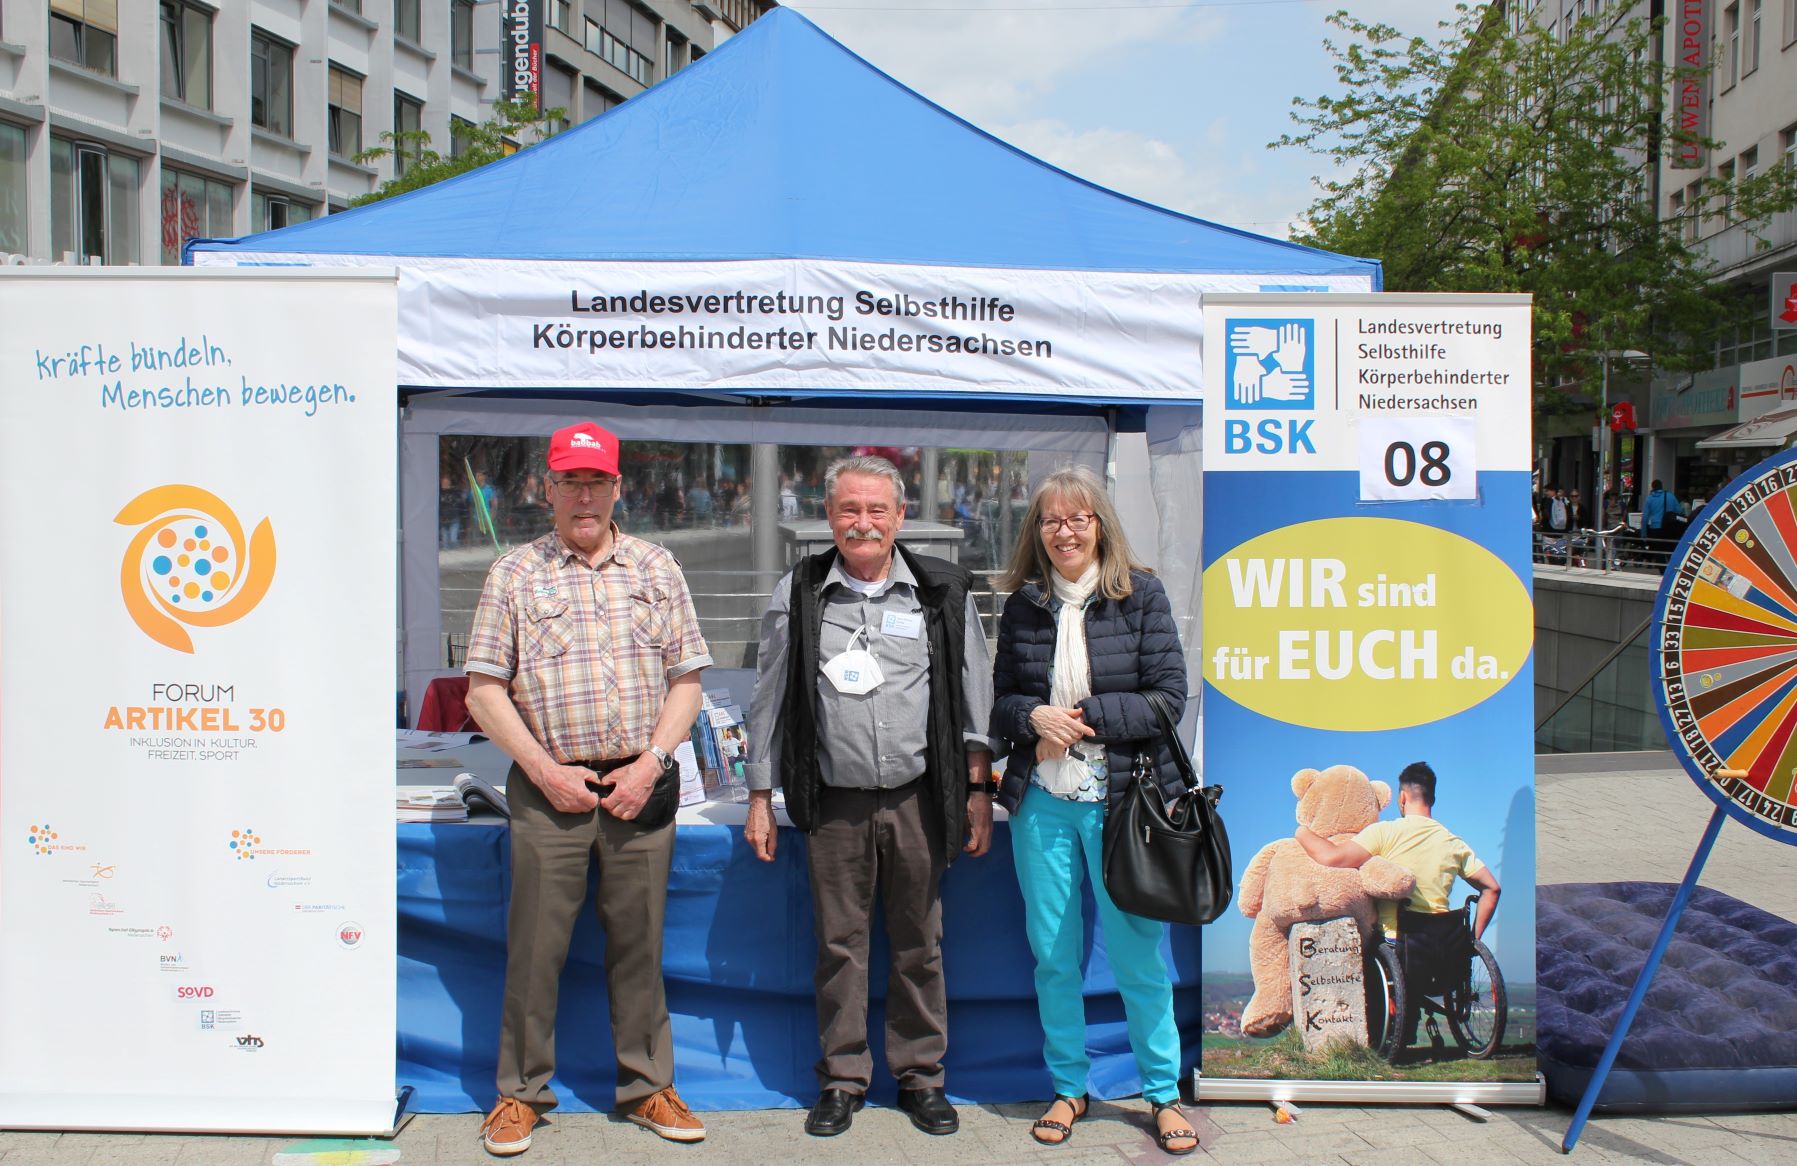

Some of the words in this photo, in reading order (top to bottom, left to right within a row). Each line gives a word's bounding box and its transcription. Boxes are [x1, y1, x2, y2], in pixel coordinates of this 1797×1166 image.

[511, 0, 532, 108] ugendub
[1681, 80, 1700, 160] LWEN
[572, 290, 843, 321] Landesvertretung
[856, 292, 1014, 322] Selbsthilfe
[1358, 318, 1502, 340] Landesvertretung
[534, 323, 817, 355] Körperbehinderter
[829, 327, 1052, 358] Niedersachsen
[36, 344, 122, 380] kräfte
[130, 334, 232, 372] bündeln,
[1358, 343, 1447, 360] Selbsthilfe
[1358, 368, 1510, 387] Körperbehinderter
[101, 376, 231, 410] Menschen
[241, 375, 356, 417] bewegen.
[1359, 393, 1478, 410] Niedersachsen
[571, 440, 601, 449] baobab
[1225, 418, 1317, 455] BSK
[1384, 441, 1452, 487] 08
[1786, 467, 1797, 483] 2
[1761, 476, 1779, 495] 16
[1736, 491, 1756, 511] 38
[1720, 512, 1733, 525] 3
[1700, 531, 1719, 550] 35
[1686, 552, 1703, 571] 10
[1226, 558, 1347, 609] WIR
[1357, 573, 1437, 608] sind
[1675, 577, 1692, 598] 29
[1669, 603, 1684, 621] 15
[1664, 631, 1680, 648] 33
[1212, 646, 1271, 681] für
[1278, 629, 1438, 681] EUCH
[1450, 645, 1510, 681] da.
[1665, 661, 1680, 670] 6
[153, 683, 234, 703] FORUM
[1668, 683, 1684, 700] 13
[104, 706, 240, 732] ARTIKEL
[248, 707, 286, 733] 30
[1675, 709, 1692, 726] 27
[130, 737, 191, 748] INKLUSION
[194, 738, 206, 748] IN
[1685, 730, 1700, 748] 18
[199, 750, 240, 761] SPORT
[1699, 756, 1718, 771] 21
[1738, 788, 1755, 806] 17
[1763, 800, 1781, 819] 24
[340, 931, 362, 940] NFV
[1300, 938, 1360, 958] Beratung
[160, 955, 177, 963] BVN
[1299, 974, 1361, 996] Selbsthilfe
[1306, 1009, 1353, 1032] Kontakt
[236, 1035, 264, 1048] vhs
